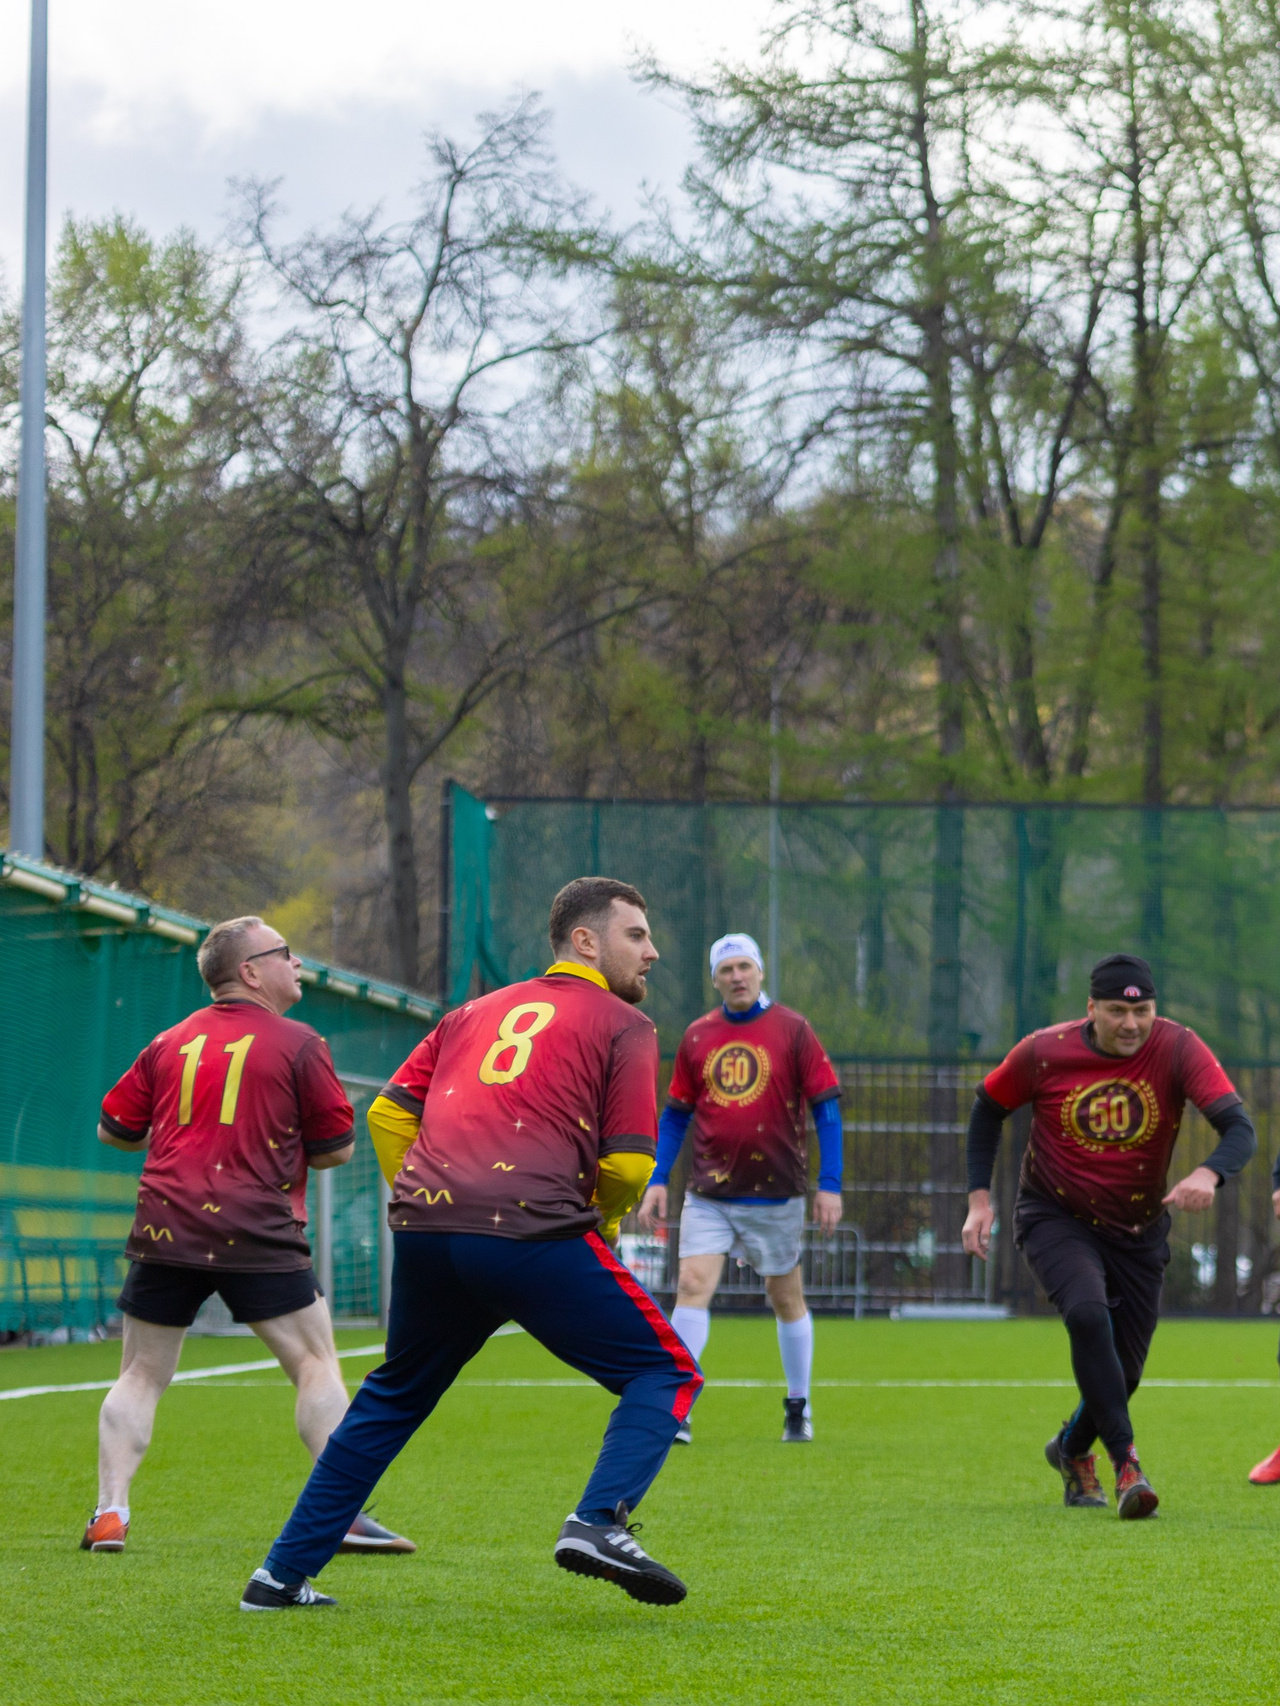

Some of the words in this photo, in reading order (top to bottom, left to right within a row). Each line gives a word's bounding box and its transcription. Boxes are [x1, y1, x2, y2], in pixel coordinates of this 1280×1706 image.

[478, 1002, 556, 1086] 8
[721, 1056, 750, 1087] 50
[178, 1034, 256, 1127] 11
[1089, 1095, 1130, 1133] 50
